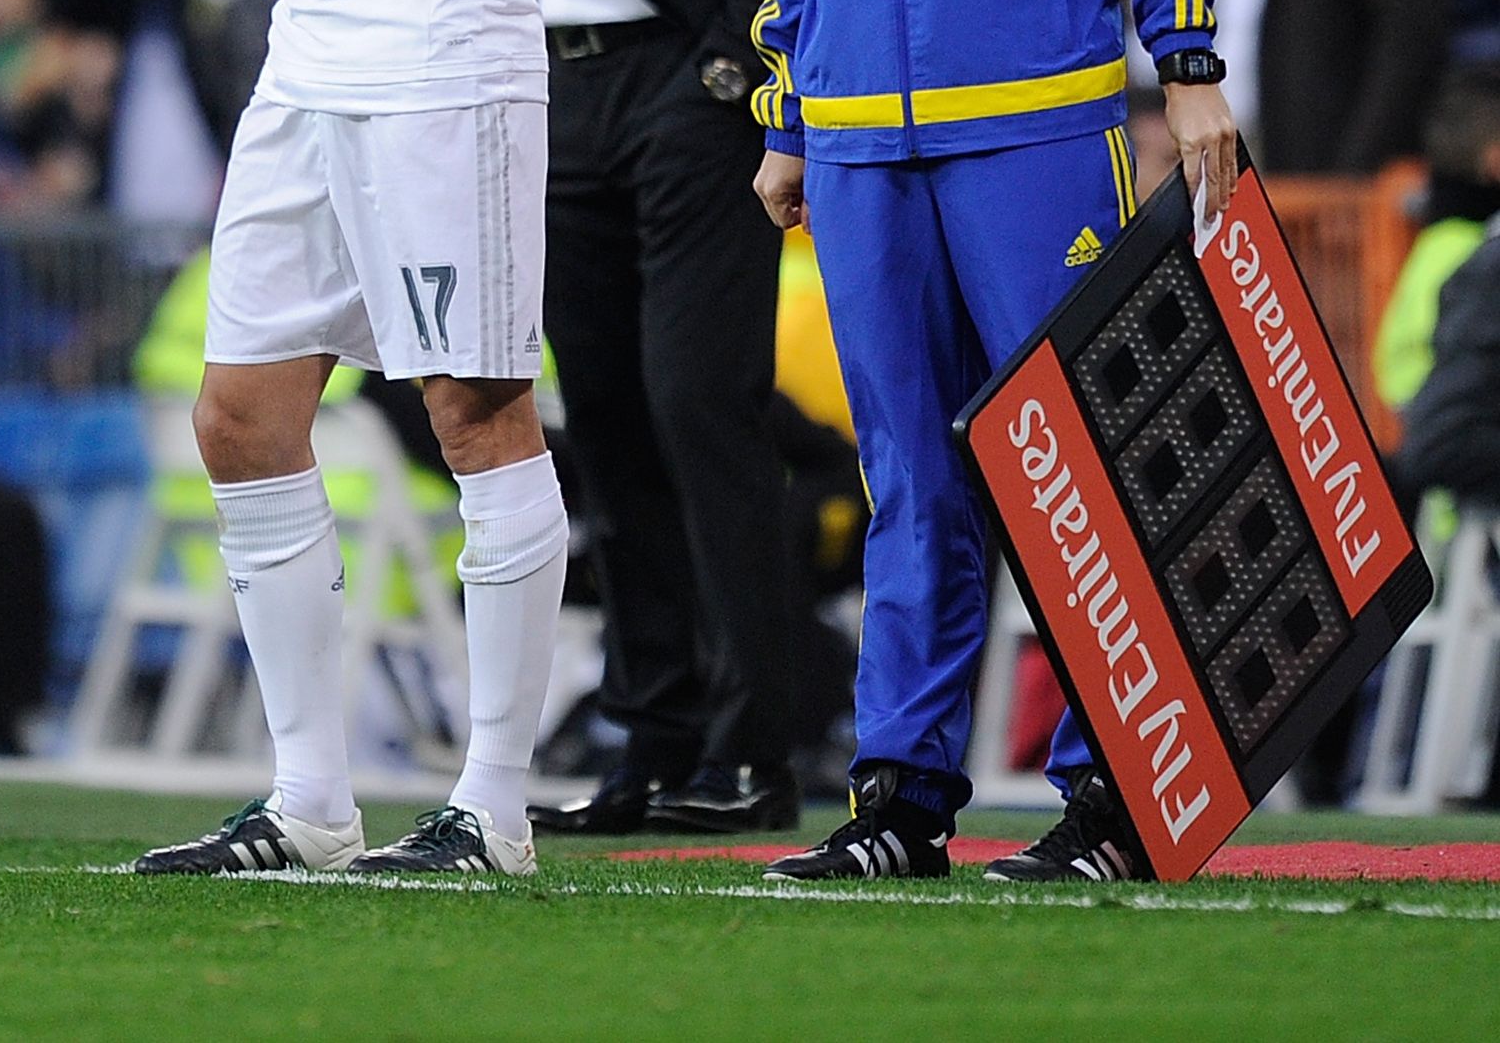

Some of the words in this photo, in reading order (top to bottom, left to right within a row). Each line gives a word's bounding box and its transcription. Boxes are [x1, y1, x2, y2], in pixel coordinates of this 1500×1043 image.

[399, 262, 458, 354] 17
[1219, 220, 1340, 482] Emirates
[1008, 399, 1159, 725] Emirates
